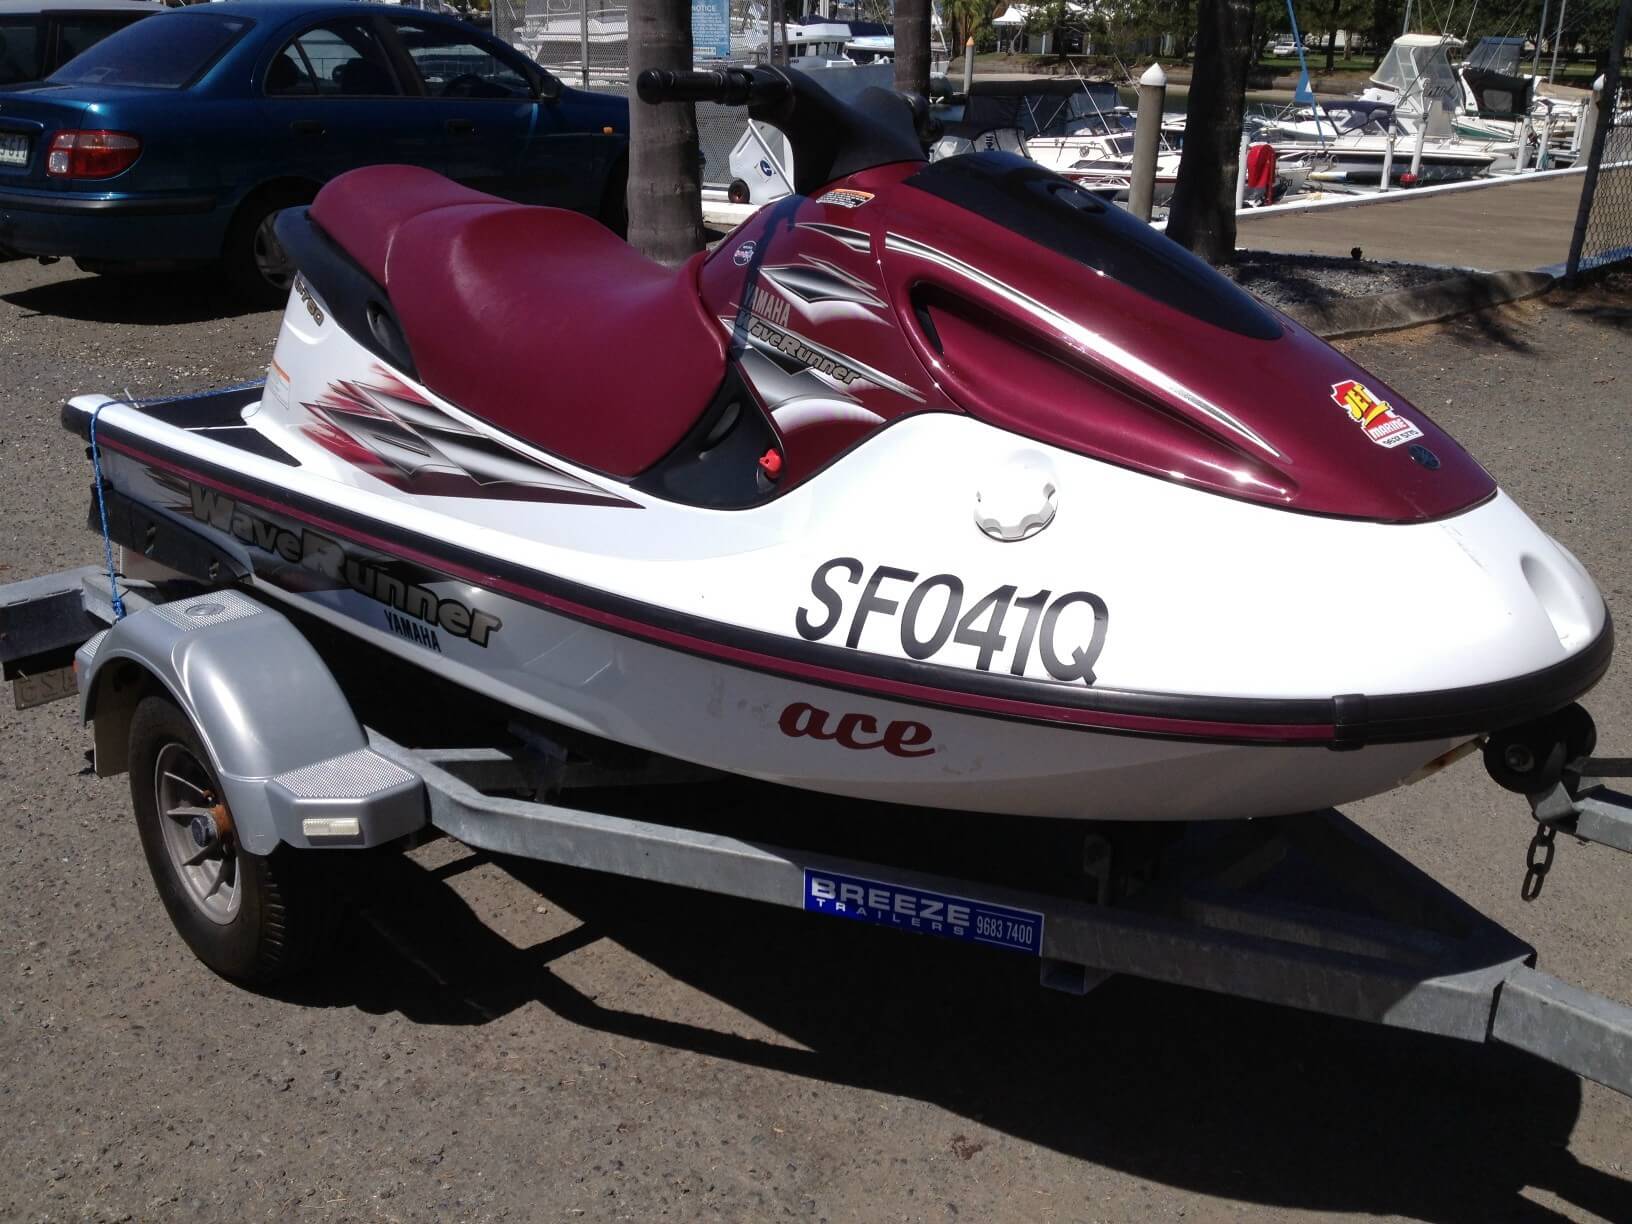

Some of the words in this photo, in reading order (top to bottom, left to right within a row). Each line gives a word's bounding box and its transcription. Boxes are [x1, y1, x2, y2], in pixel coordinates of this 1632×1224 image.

[742, 281, 791, 328] YAMAHA
[735, 309, 861, 385] WaveRunner
[1343, 383, 1391, 428] JET
[189, 481, 503, 648] WaveRunner
[383, 608, 442, 653] YAMAHA
[777, 701, 937, 758] ace
[811, 876, 970, 927] BREEZE
[815, 897, 965, 936] TRAILERS
[976, 915, 1003, 938] 9683
[1006, 920, 1033, 945] 7400
